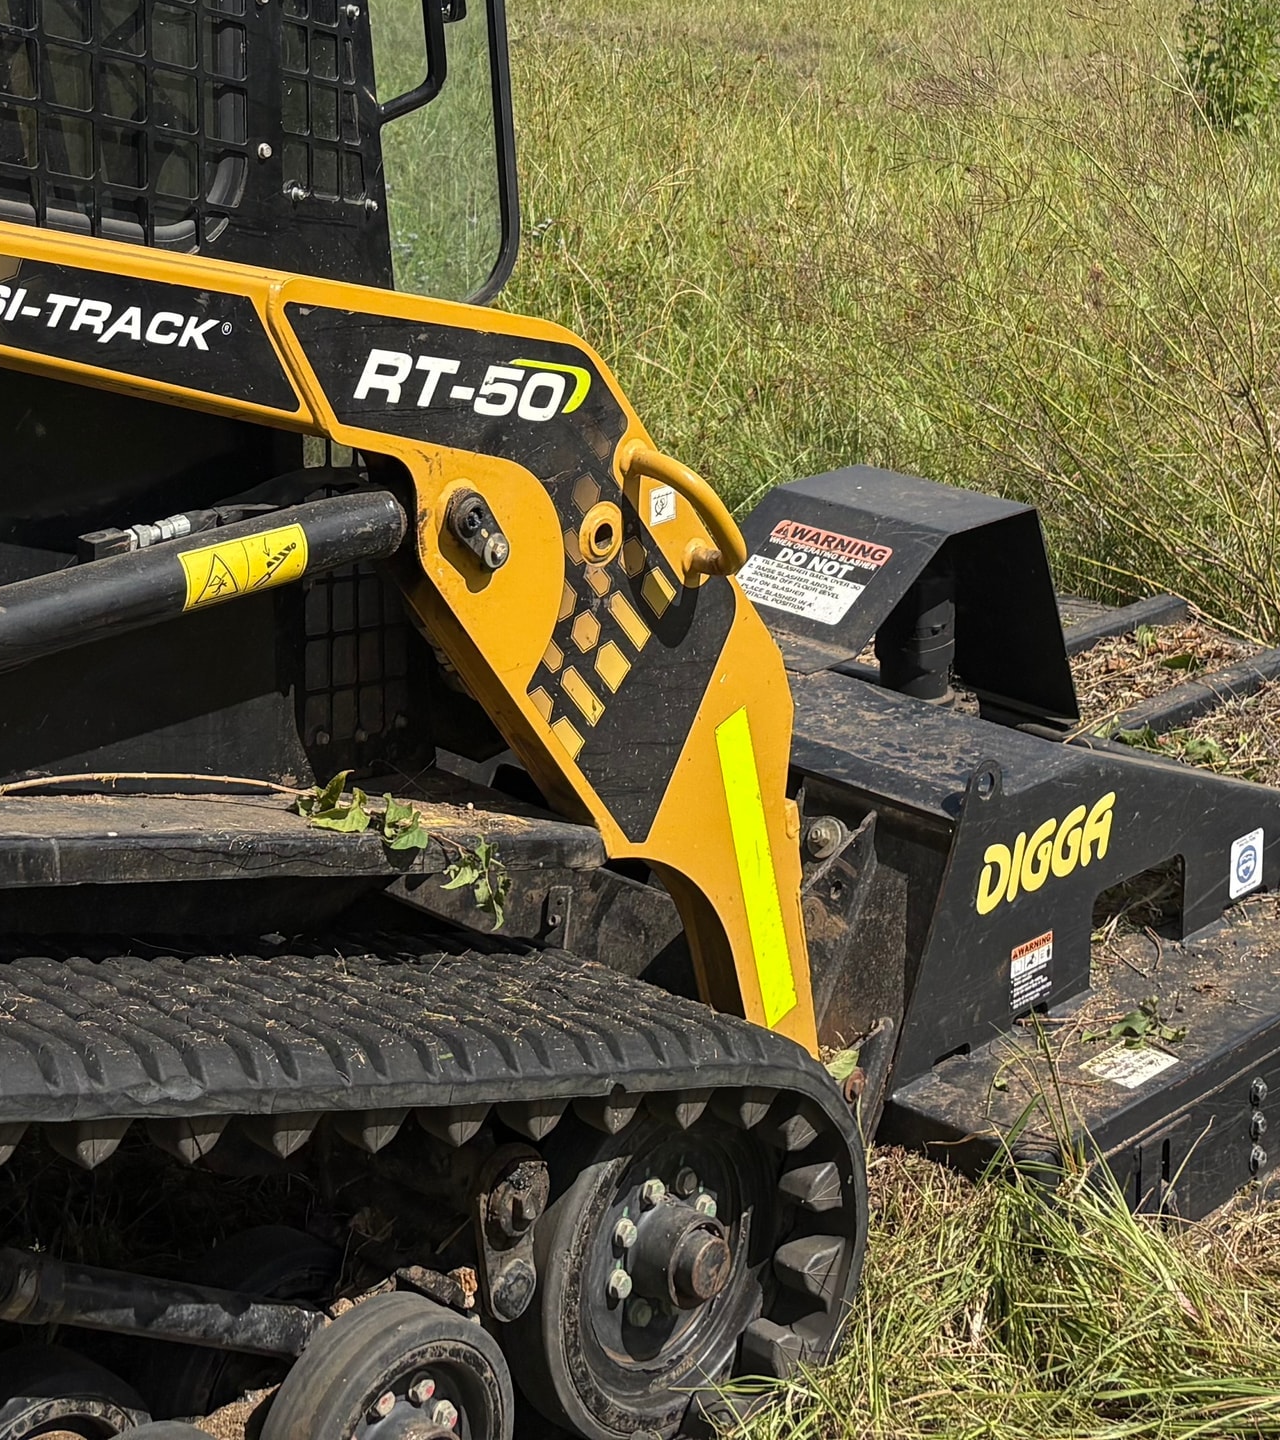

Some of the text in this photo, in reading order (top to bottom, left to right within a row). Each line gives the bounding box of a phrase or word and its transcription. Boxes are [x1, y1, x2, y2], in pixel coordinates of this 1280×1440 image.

[353, 348, 566, 422] RT-50
[791, 525, 888, 561] WARNING
[775, 547, 855, 579] DO NOT
[839, 555, 878, 571] SLASHER
[976, 791, 1116, 916] DIGGA
[1018, 933, 1052, 955] WARNING
